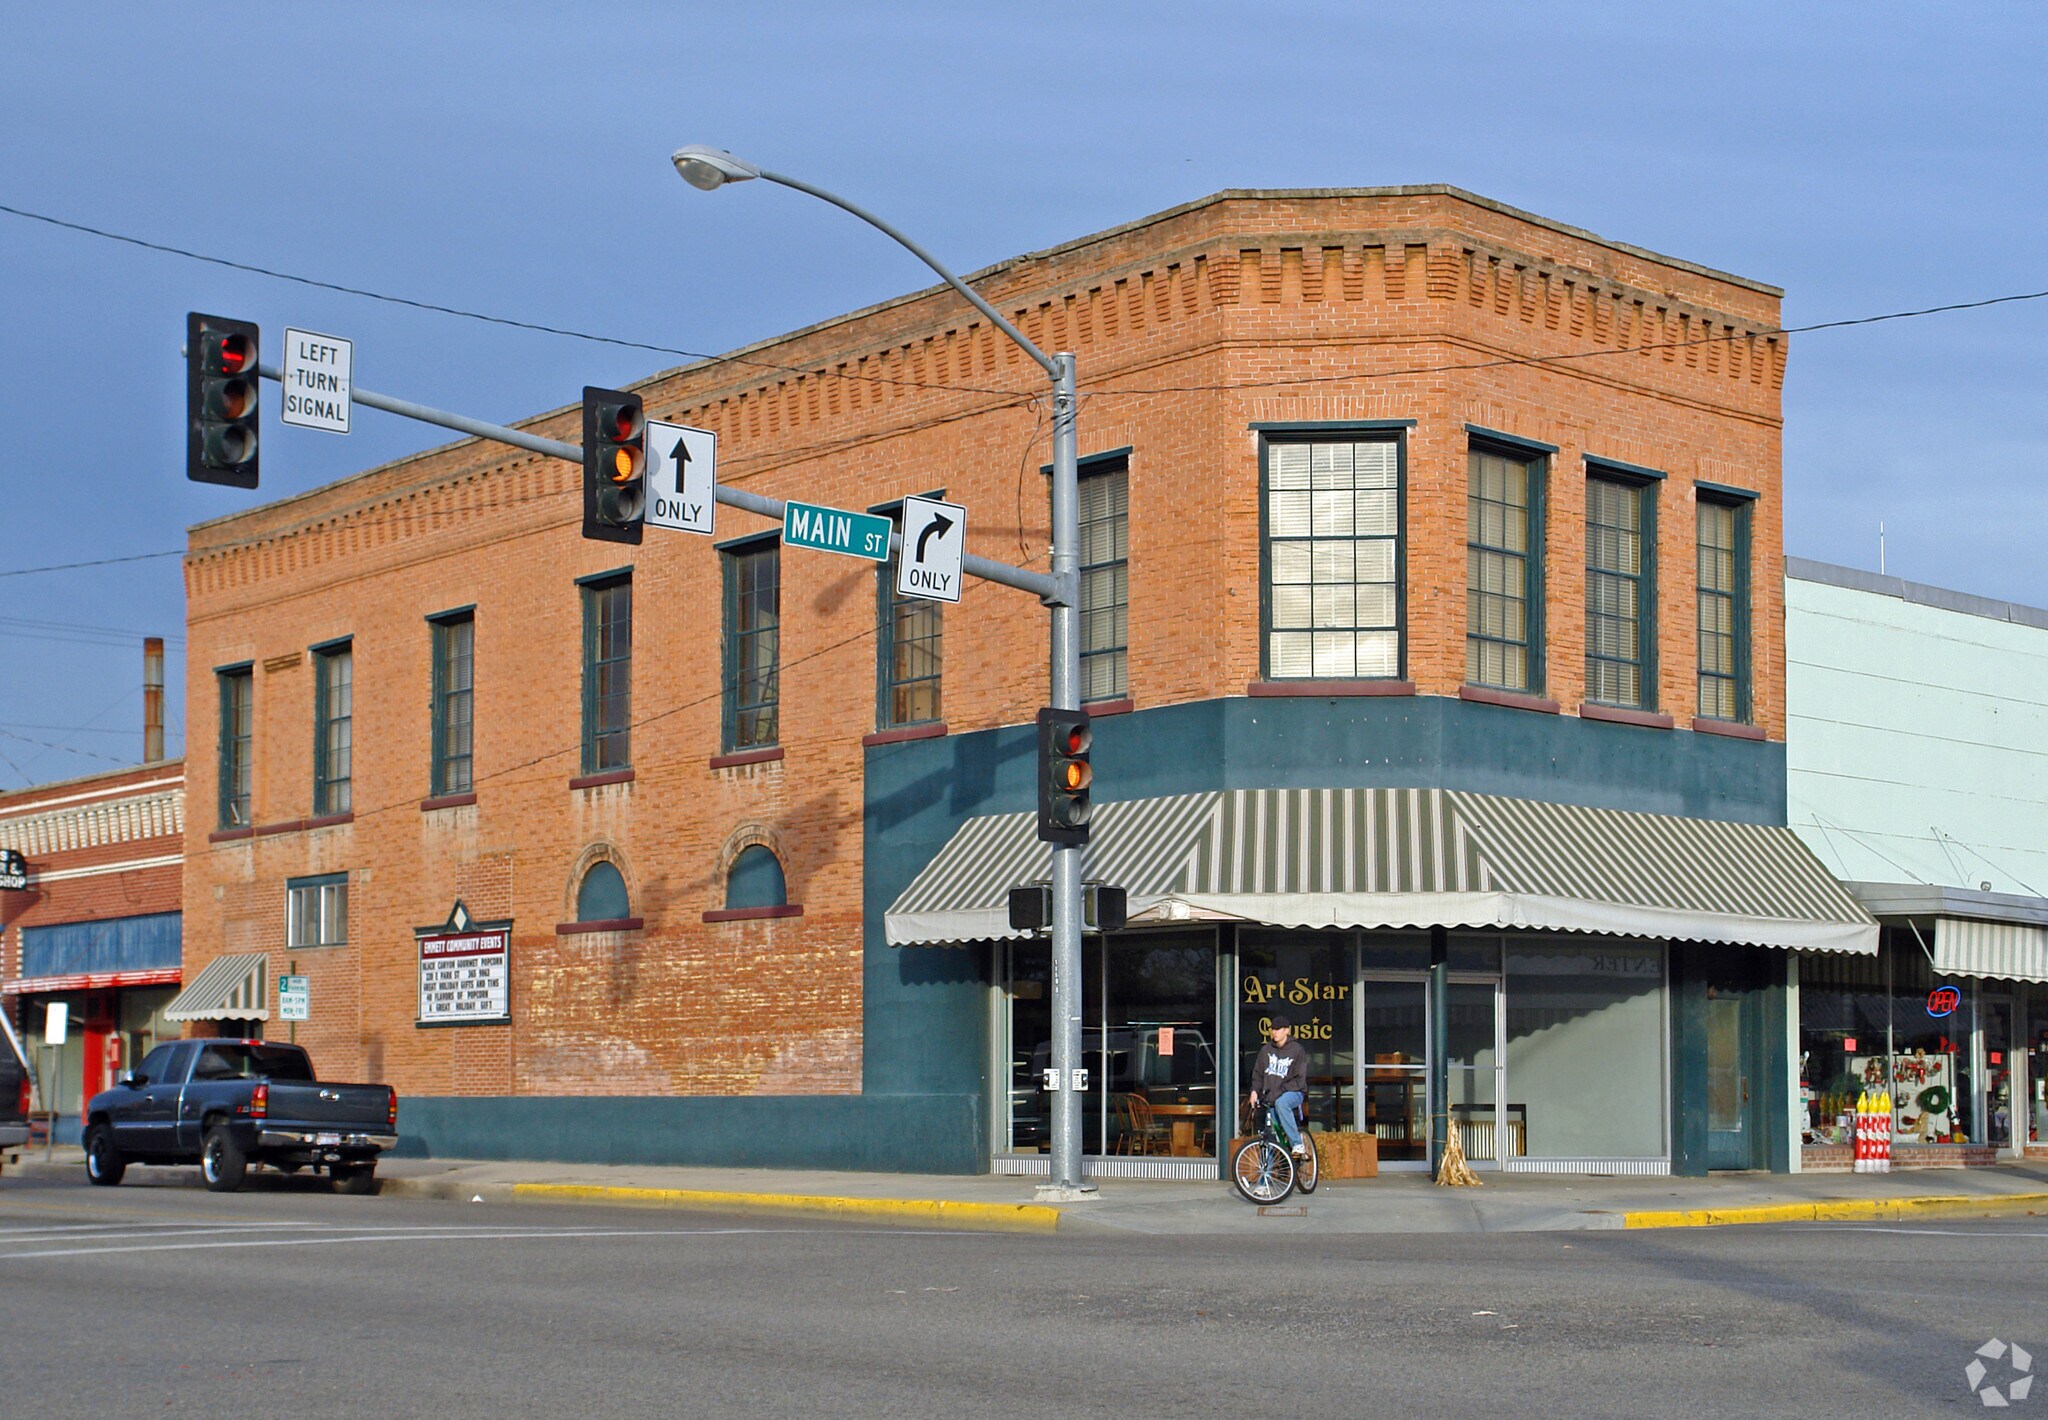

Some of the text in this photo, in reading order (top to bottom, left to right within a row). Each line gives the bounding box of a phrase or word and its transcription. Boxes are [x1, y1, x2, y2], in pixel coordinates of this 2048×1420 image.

[300, 341, 337, 365] LEFT
[297, 368, 338, 393] TURN
[287, 395, 345, 421] SIGNAL
[655, 498, 702, 523] ONLY
[791, 508, 883, 553] MAIN ST
[909, 569, 951, 591] ONLY
[424, 936, 502, 954] EMMETT COMMUNITY EVENTS
[438, 960, 455, 970] CANYON
[457, 959, 478, 969] GOURMET
[481, 957, 503, 966] POPCORN
[281, 978, 287, 991] 2
[440, 971, 452, 979] PARK
[423, 982, 436, 991] GREAT
[439, 981, 458, 991] HOLIDAY
[460, 980, 474, 989] GIFTS
[477, 979, 485, 988] AND
[434, 992, 454, 1001] FLAVORS
[457, 991, 463, 999] OF
[467, 990, 488, 999] POPCORN
[1928, 991, 1958, 1012] OPEN
[436, 1003, 450, 1011] GREAT
[456, 1002, 475, 1011] HOLIDAY
[480, 1000, 492, 1010] GIFT
